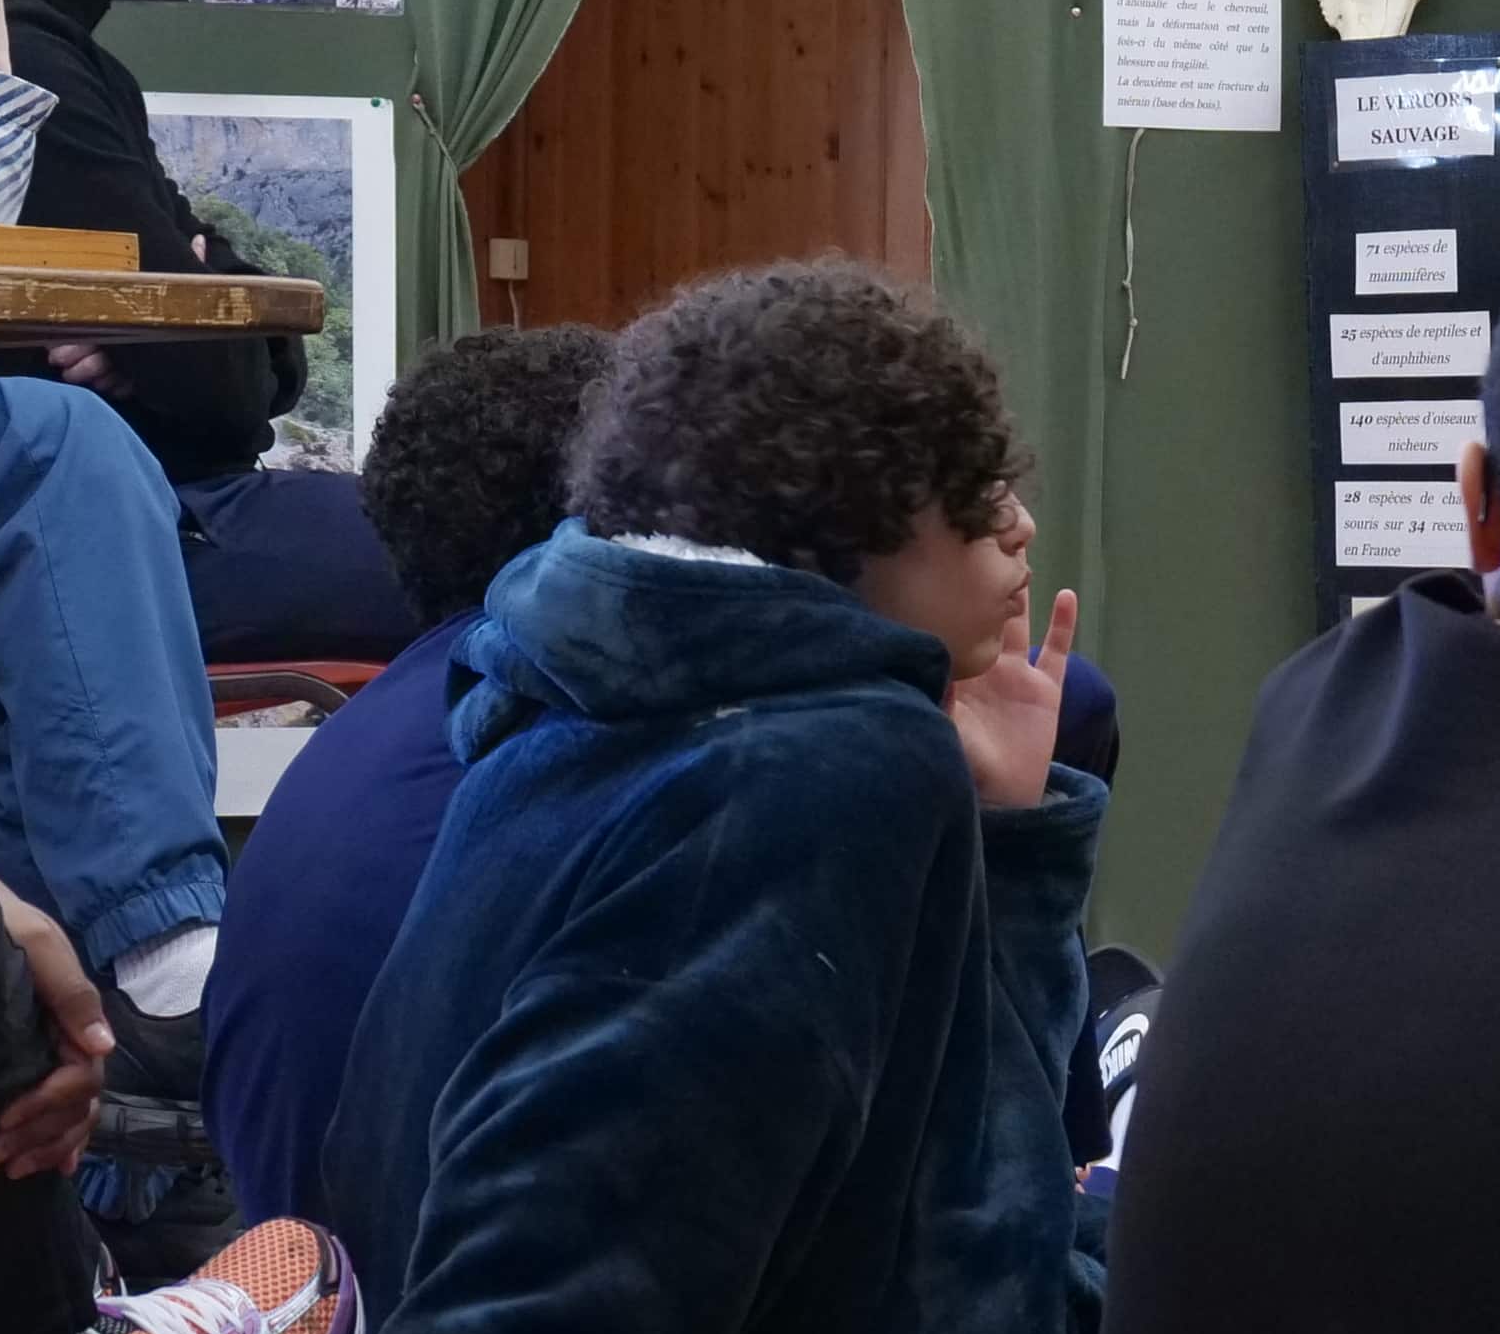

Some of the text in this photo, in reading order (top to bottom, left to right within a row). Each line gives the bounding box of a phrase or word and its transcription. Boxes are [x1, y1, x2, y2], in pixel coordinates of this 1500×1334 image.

[1357, 96, 1380, 112] LE
[1371, 126, 1459, 144] SAUVAGE
[1366, 238, 1448, 257] 71 espèces de
[1369, 268, 1445, 282] mammifères
[1340, 324, 1482, 341] 25 espèces de reptiles et
[1372, 351, 1450, 367] d'amphibiens
[1350, 412, 1477, 428] 140 espèces d'oiseaux
[1388, 438, 1439, 452] nicheurs
[1344, 543, 1401, 557] en France
